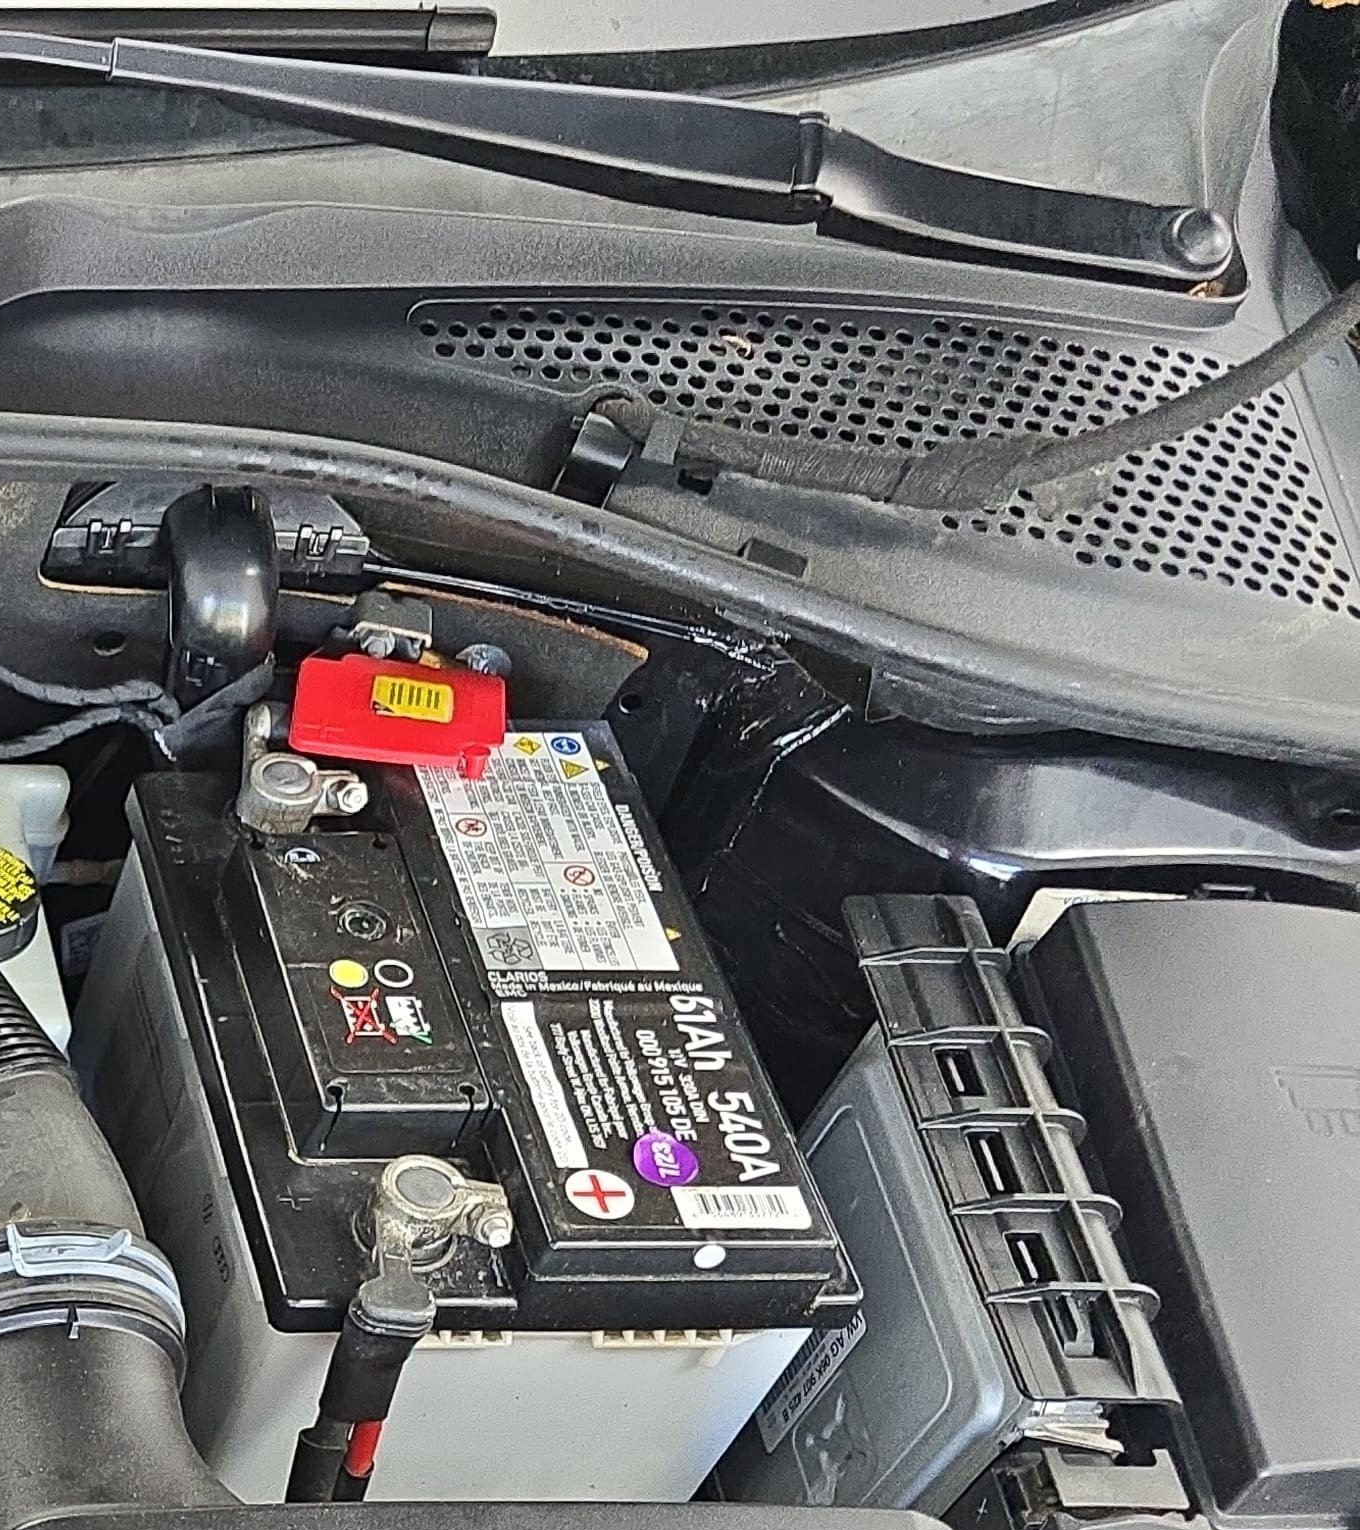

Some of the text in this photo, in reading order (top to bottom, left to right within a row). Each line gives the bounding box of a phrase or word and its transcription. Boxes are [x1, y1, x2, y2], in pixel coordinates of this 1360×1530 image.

[487, 971, 548, 983] CLARIOS
[654, 980, 703, 993] Mexique
[636, 1029, 662, 1057] 000
[648, 1057, 674, 1086] 915
[669, 994, 780, 1182] 61Ah 540A
[658, 1088, 686, 1116] 105
[690, 1100, 710, 1123] DIN
[670, 1118, 697, 1142] DE
[846, 1314, 863, 1342] VW
[830, 1331, 844, 1356] AG
